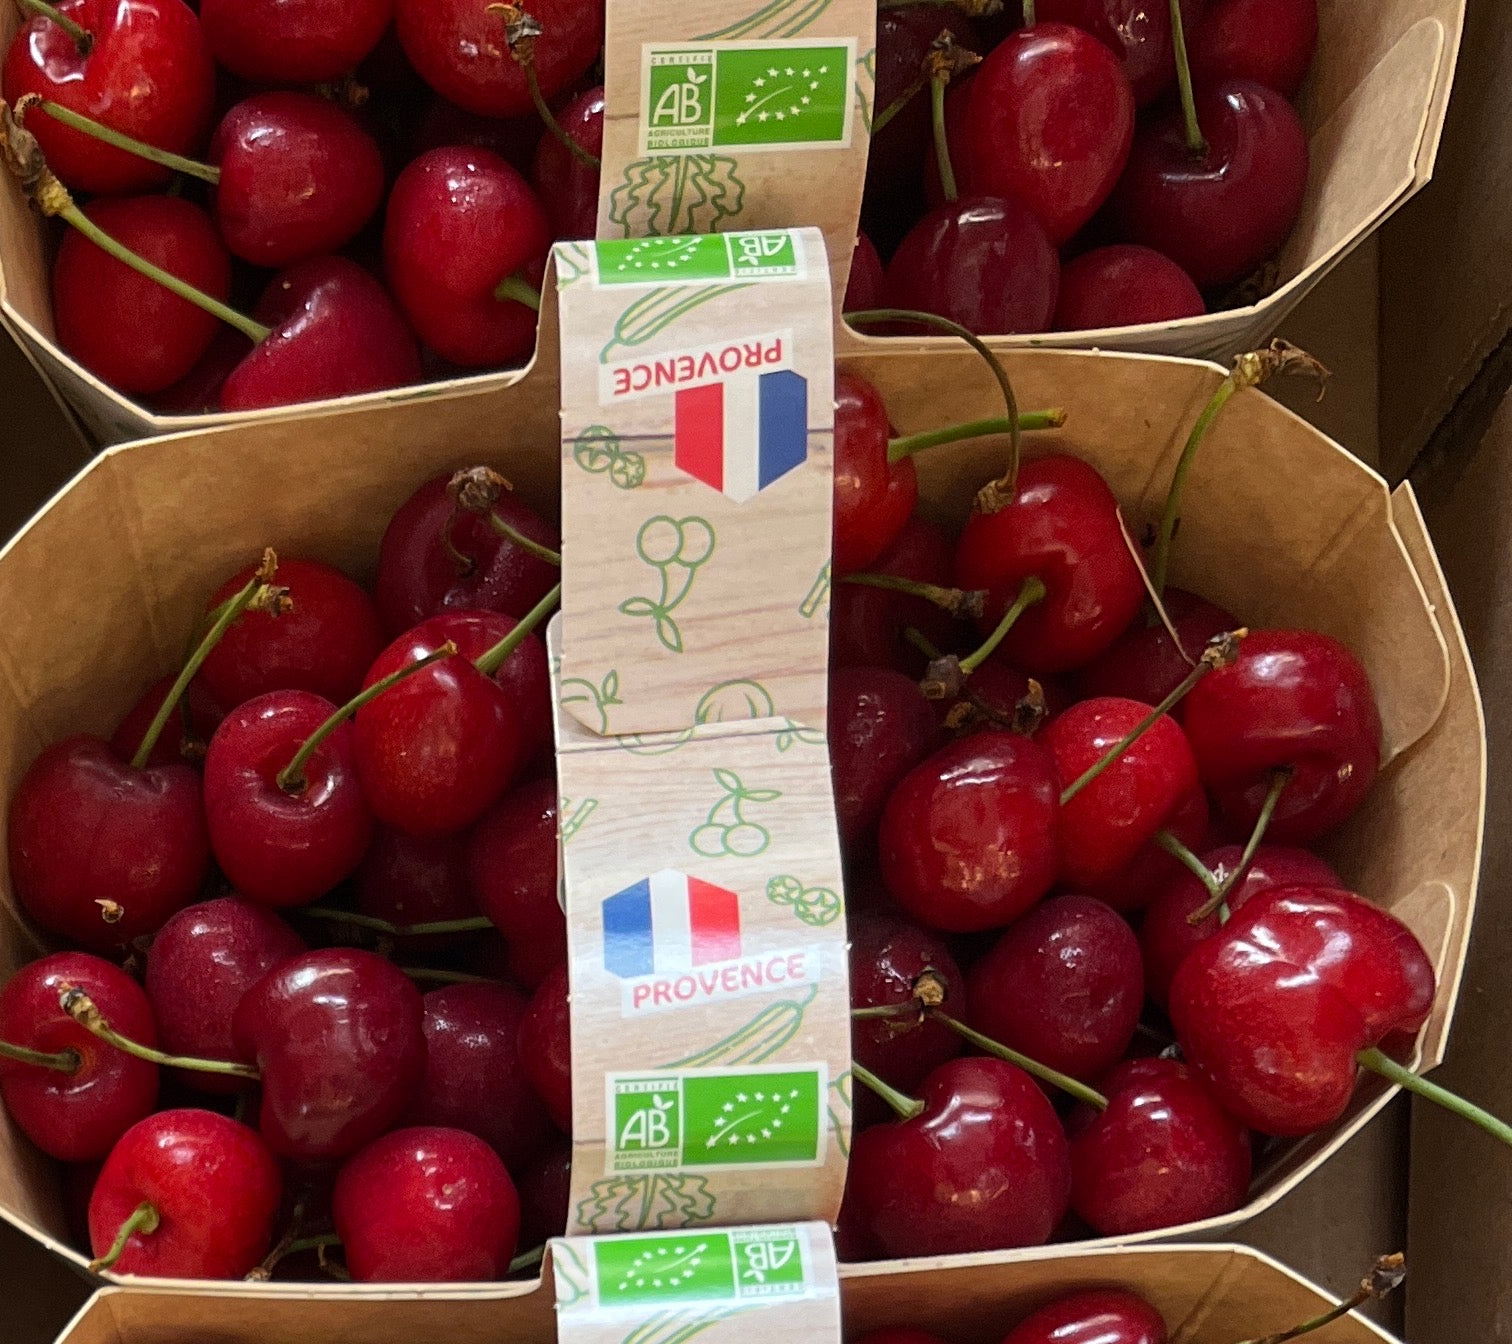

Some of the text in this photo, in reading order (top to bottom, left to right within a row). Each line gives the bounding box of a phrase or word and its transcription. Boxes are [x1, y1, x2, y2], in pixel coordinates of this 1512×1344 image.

[652, 83, 702, 125] AB
[647, 137, 709, 147] BIOLOGIQUE
[648, 127, 710, 137] AGRICULTURE
[739, 236, 787, 257] AB
[613, 338, 782, 396] PROVENCE
[632, 953, 807, 1009] PROVENCE
[619, 1108, 670, 1150] AB
[744, 1241, 795, 1270] AB
